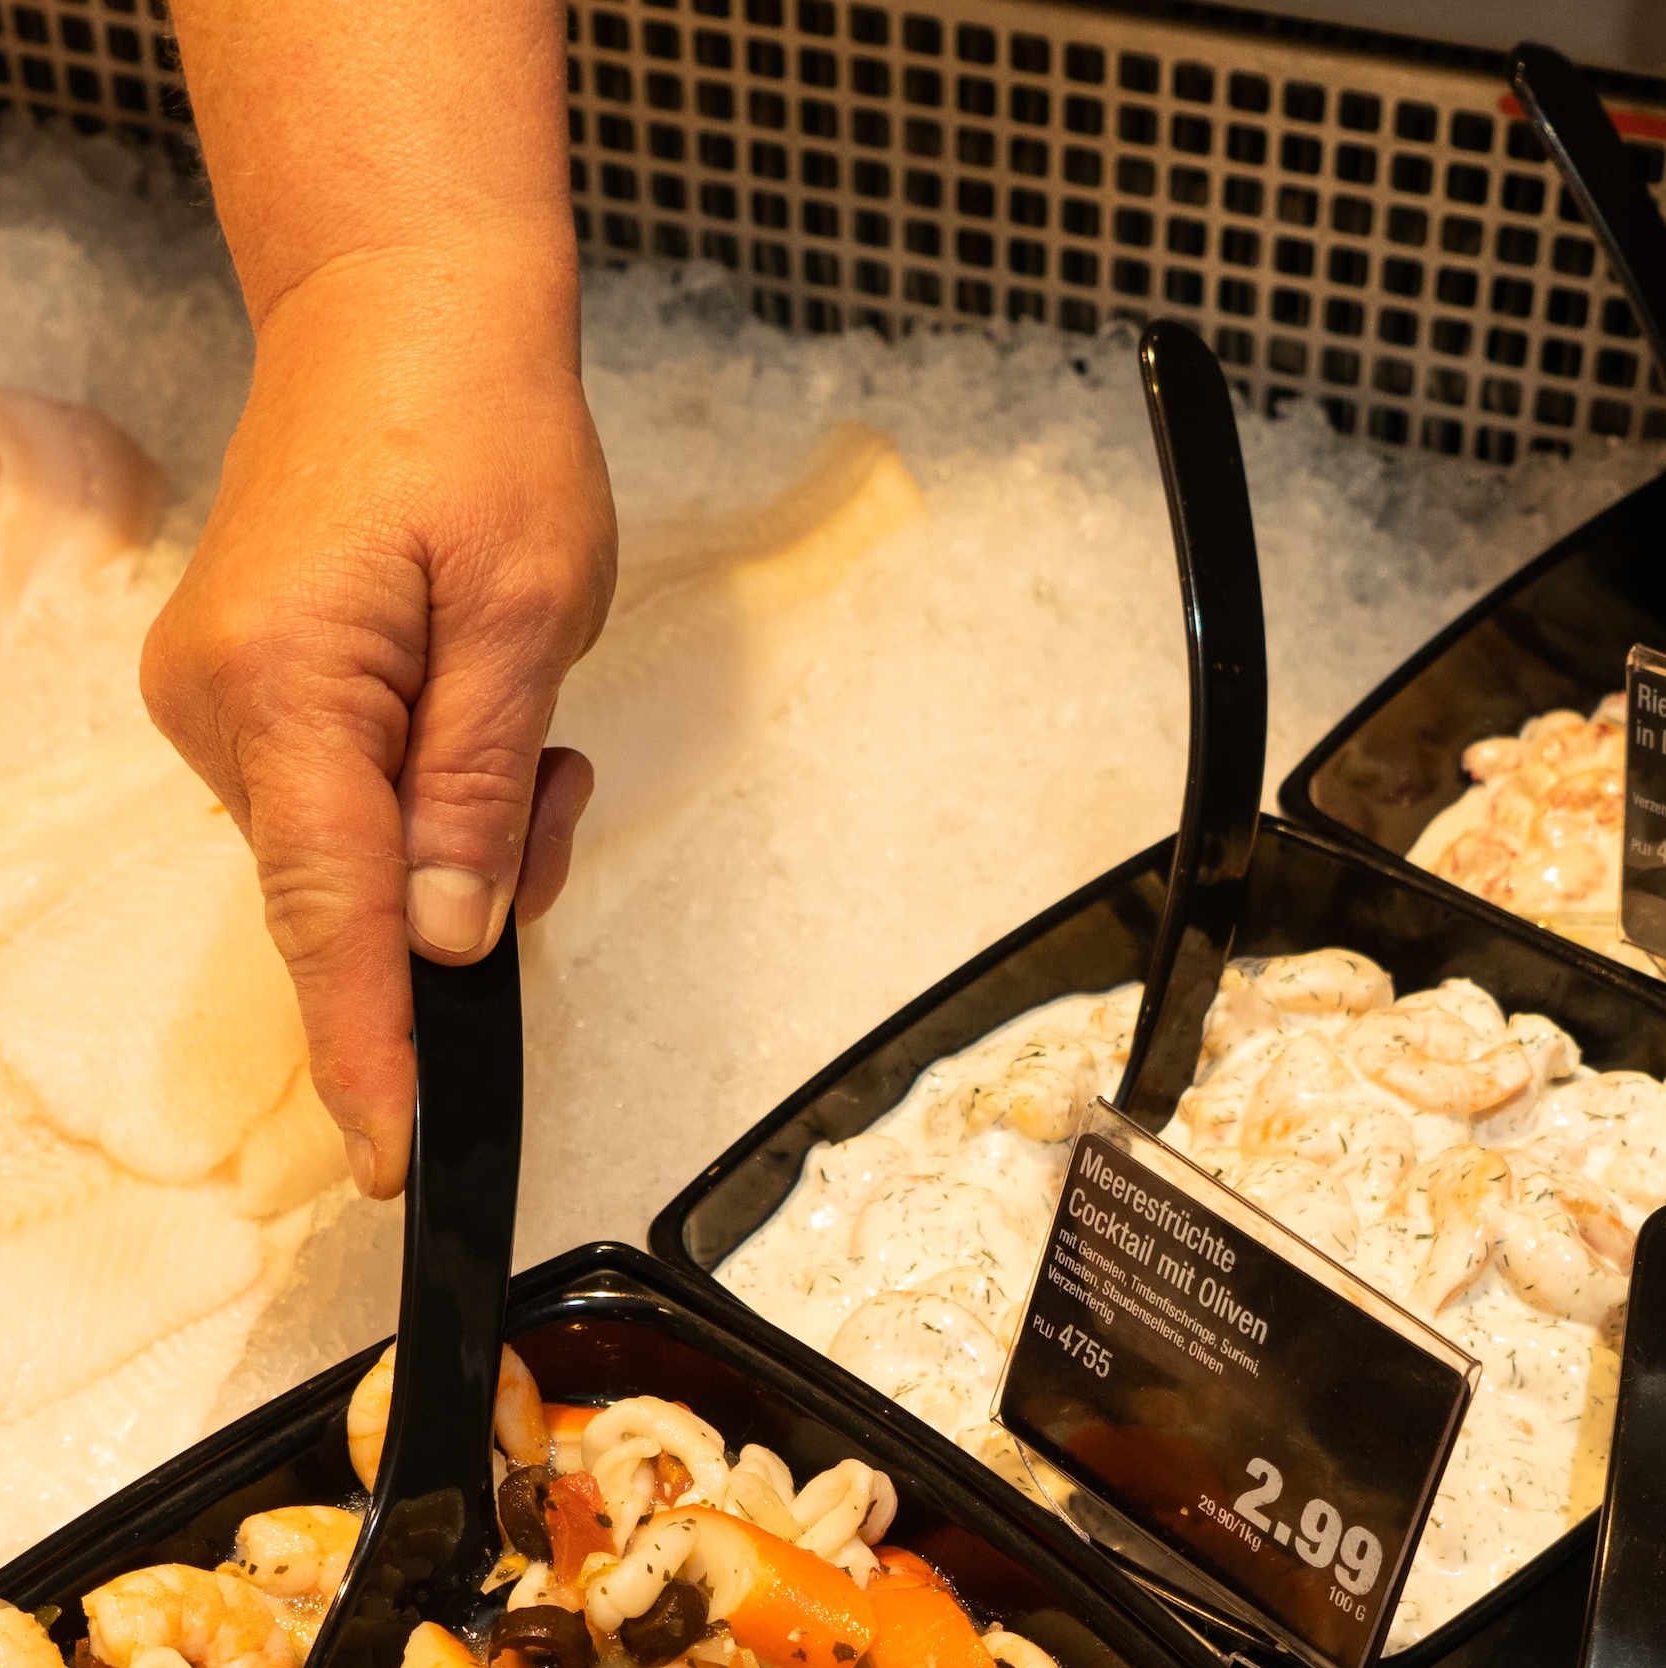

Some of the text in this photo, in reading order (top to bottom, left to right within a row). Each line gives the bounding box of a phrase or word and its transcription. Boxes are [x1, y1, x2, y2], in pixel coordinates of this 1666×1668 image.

[1636, 719, 1655, 750] in
[1079, 1146, 1237, 1274] Meeresfrüchte
[1047, 1264, 1116, 1325] Verzehrfertig
[1054, 1244, 1224, 1376] Tomaten, Staudensellerie, Oliven
[1058, 1228, 1260, 1378] mit Garnelen, Tintenfischringe, Surimi,
[1068, 1188, 1269, 1347] Cocktail mit Oliven
[1033, 1314, 1114, 1379] PLU 4755
[1197, 1494, 1263, 1553] 29.90/1kg
[1233, 1457, 1384, 1596] 2.99
[1328, 1584, 1367, 1622] 100 G
